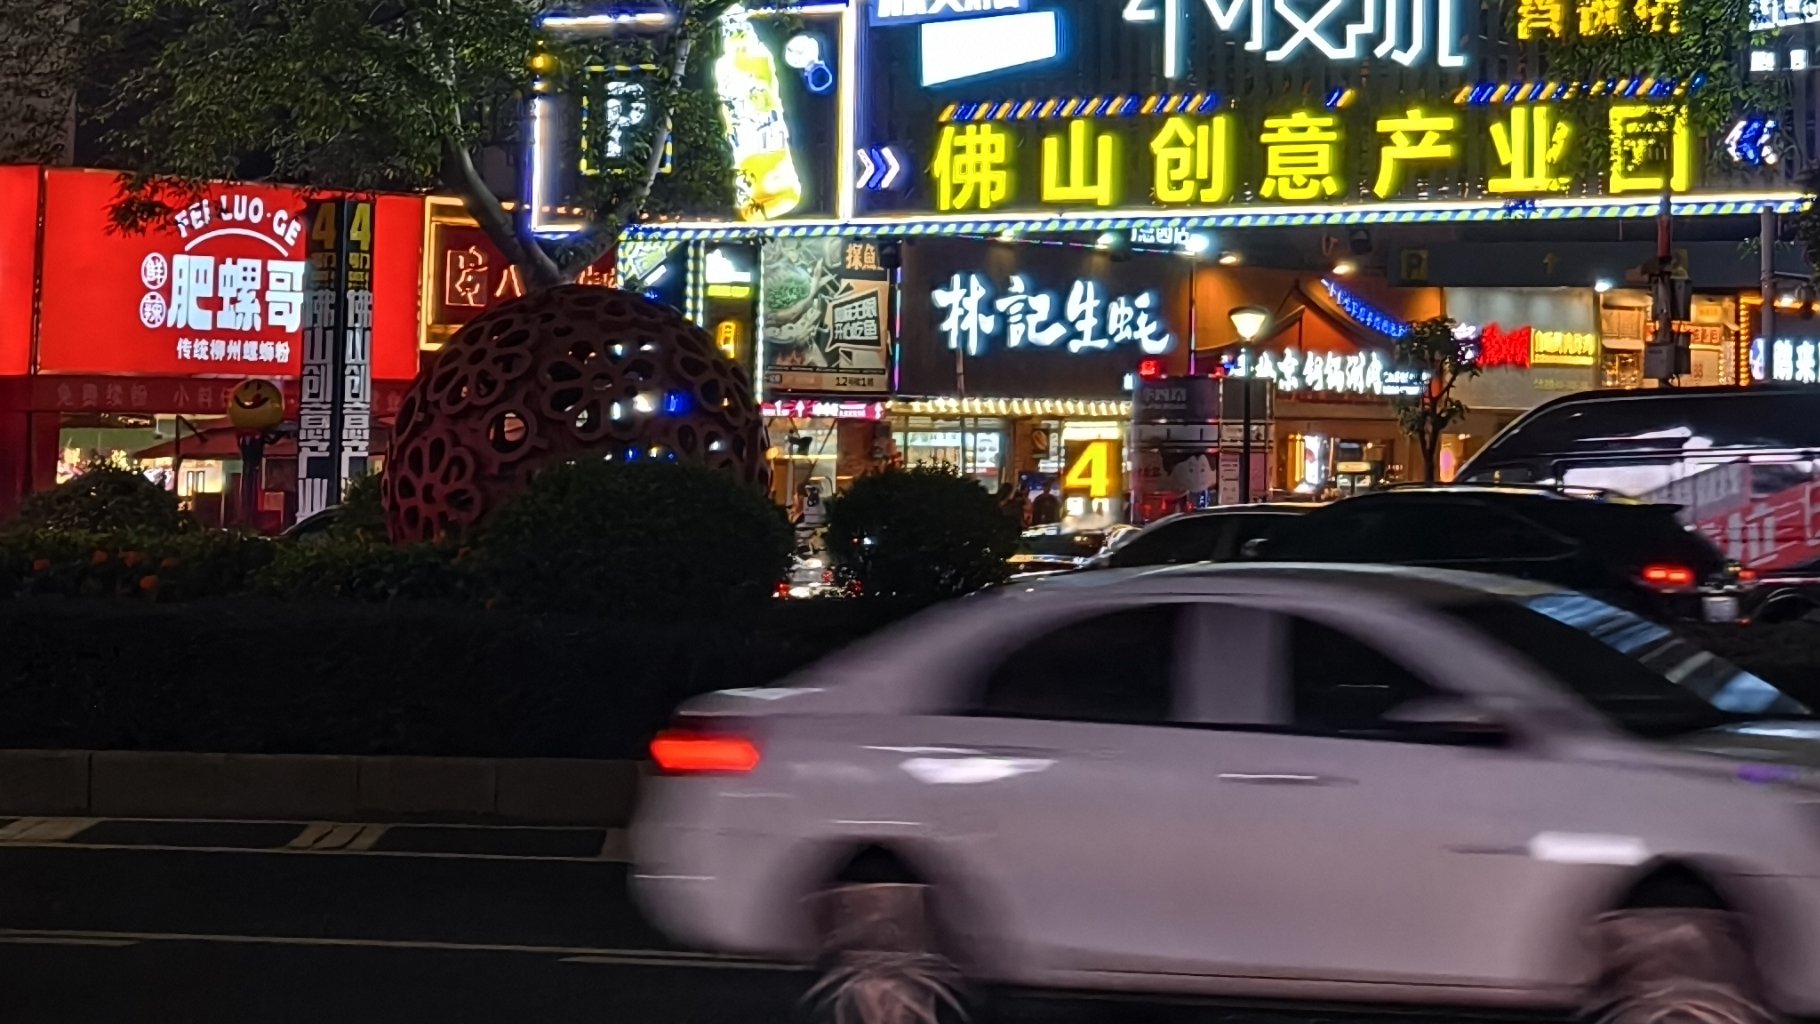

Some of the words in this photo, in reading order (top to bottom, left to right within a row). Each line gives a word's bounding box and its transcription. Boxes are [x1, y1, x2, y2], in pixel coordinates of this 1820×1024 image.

[932, 105, 1689, 211] 佛山创意产业园
[174, 198, 211, 238] FEI
[311, 202, 336, 250] 4
[349, 202, 371, 251] 4
[166, 253, 305, 333] 肥螺哥
[932, 273, 1170, 356] 林記生蚝
[341, 289, 373, 502] 佛山创意产
[1064, 440, 1110, 497] 4
